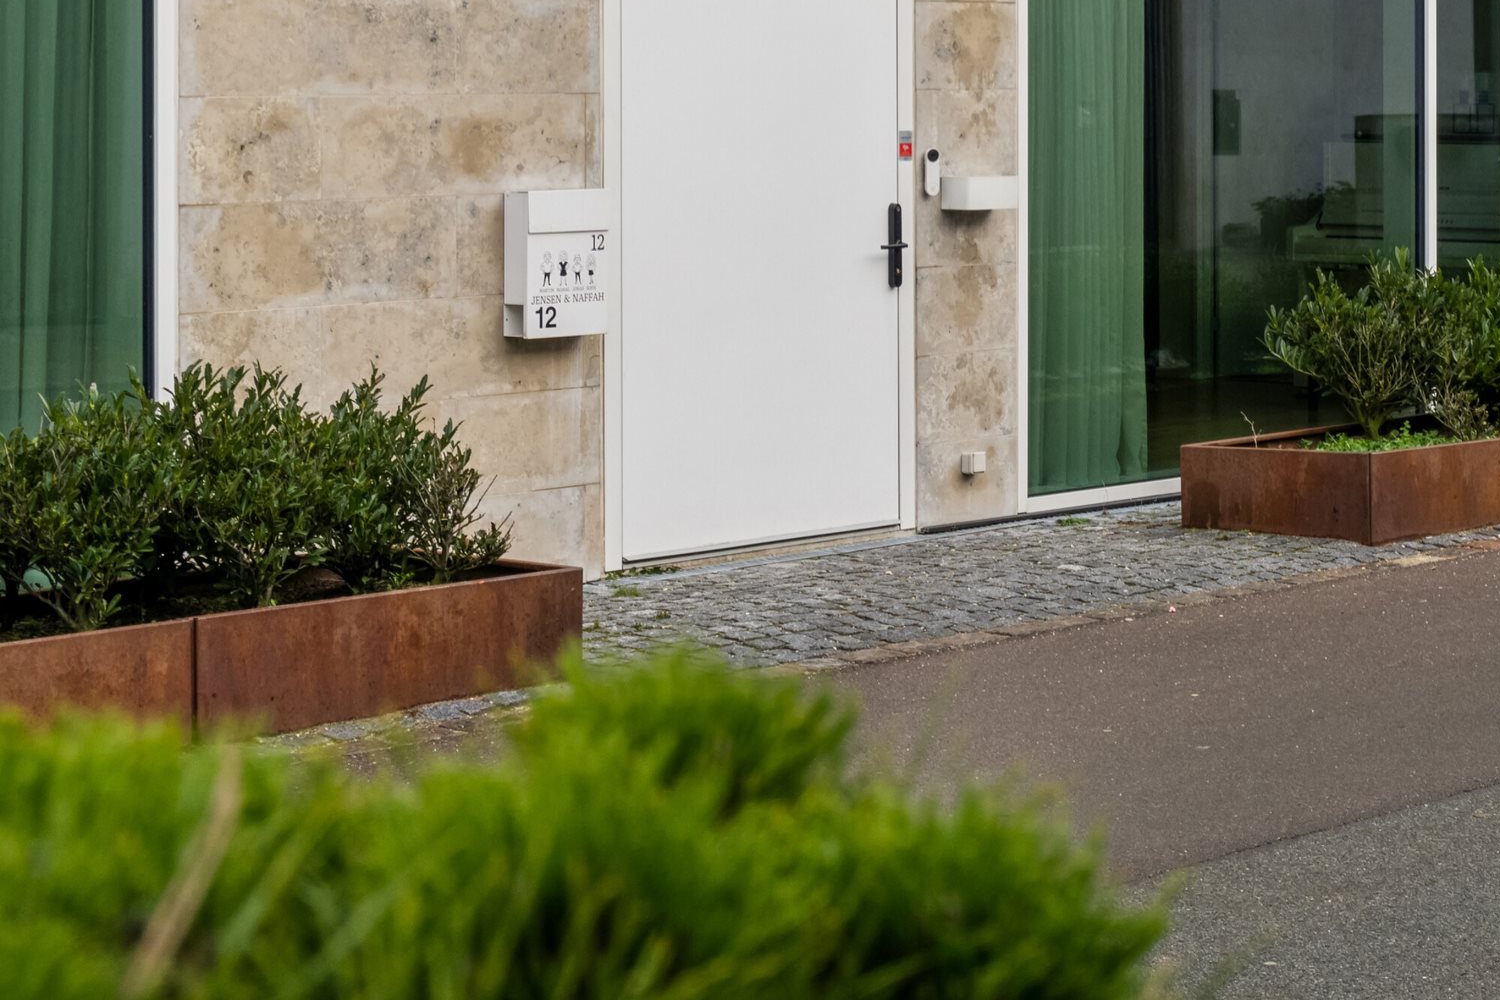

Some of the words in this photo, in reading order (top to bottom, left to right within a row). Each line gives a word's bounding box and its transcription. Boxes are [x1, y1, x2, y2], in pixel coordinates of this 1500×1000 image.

[591, 233, 605, 251] 12
[531, 294, 562, 305] JENSEN
[564, 294, 570, 303] &
[572, 292, 604, 303] NAFFAH
[535, 306, 557, 329] 12
